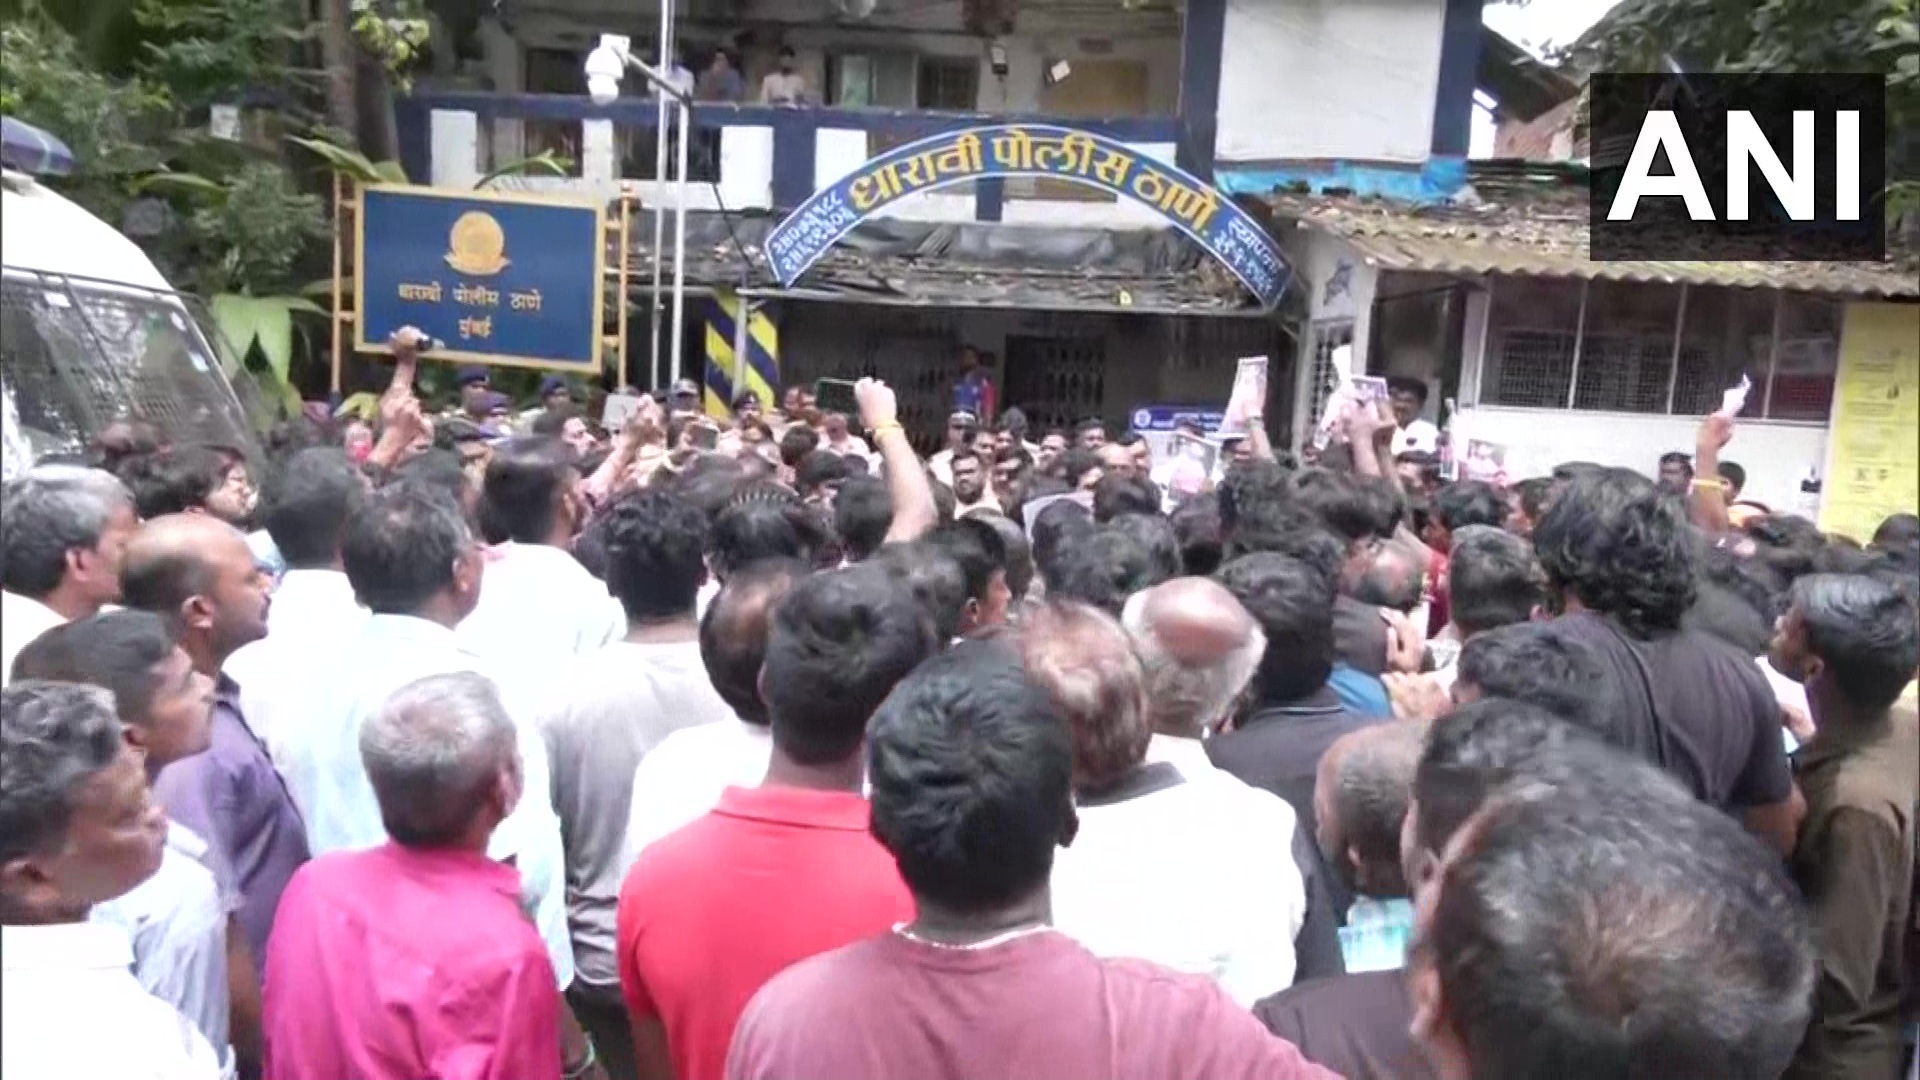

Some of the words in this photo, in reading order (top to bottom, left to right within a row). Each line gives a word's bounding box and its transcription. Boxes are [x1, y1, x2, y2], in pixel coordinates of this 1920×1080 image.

[850, 131, 983, 210] धारावी
[991, 128, 1135, 186] पोलीस
[509, 288, 543, 311] ठाणे
[458, 315, 493, 340] मुंबई
